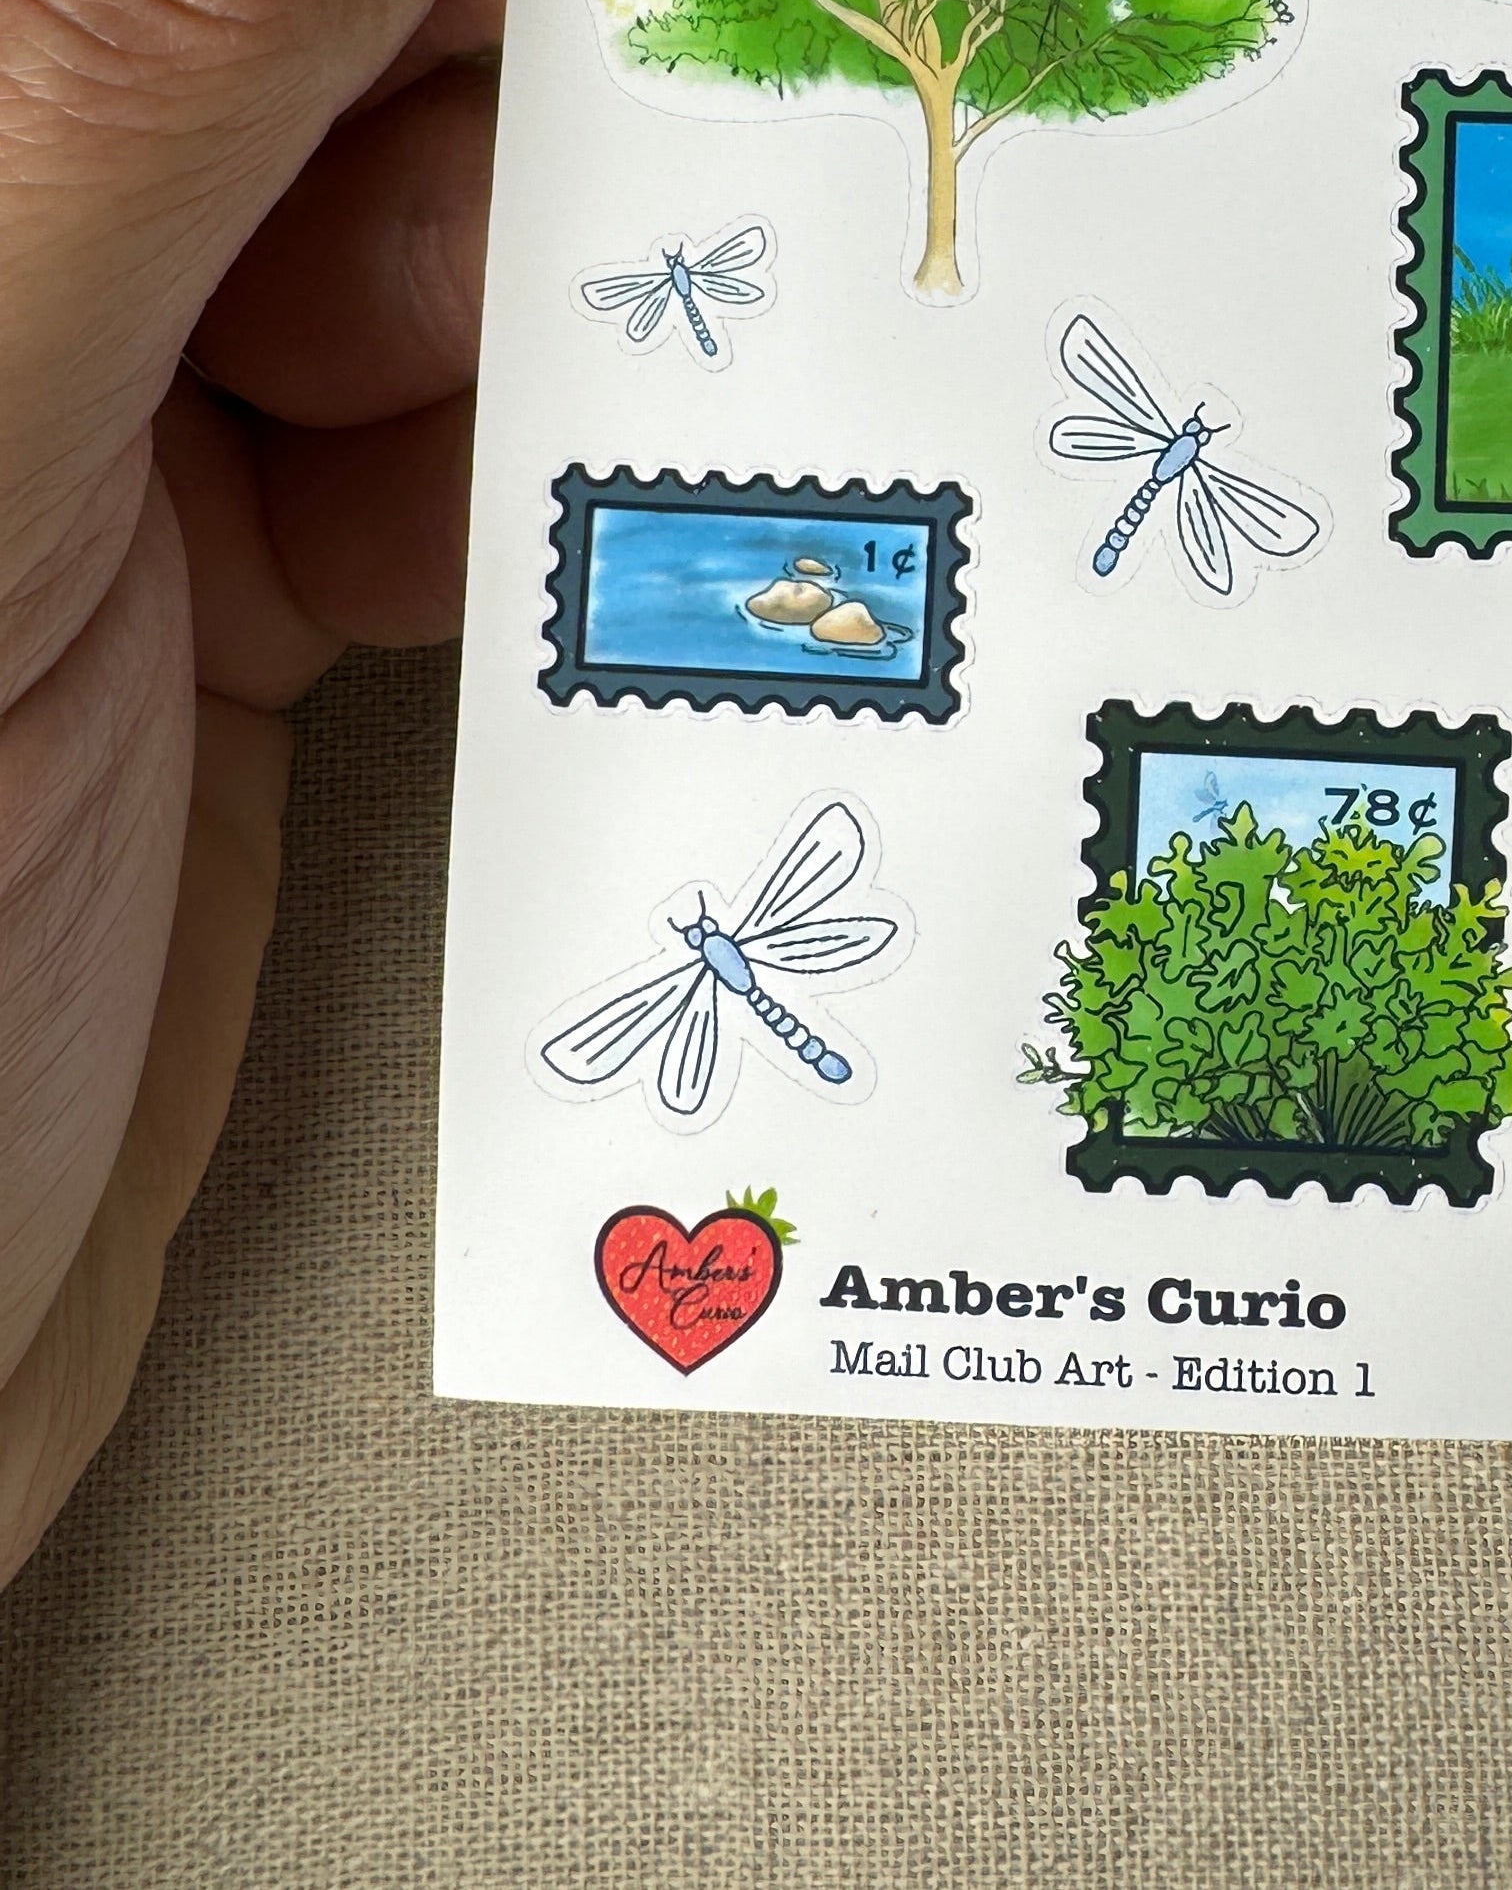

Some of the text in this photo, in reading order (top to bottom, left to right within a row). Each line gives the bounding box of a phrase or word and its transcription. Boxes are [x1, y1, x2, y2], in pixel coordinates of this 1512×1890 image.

[1324, 787, 1438, 836] 78¢
[819, 1264, 1347, 1330] Amber's Curio
[830, 1339, 930, 1378] Mail
[943, 1345, 1042, 1384] Club
[1054, 1351, 1133, 1388] Art
[1172, 1355, 1338, 1396] Edition
[1355, 1362, 1376, 1397] 1
